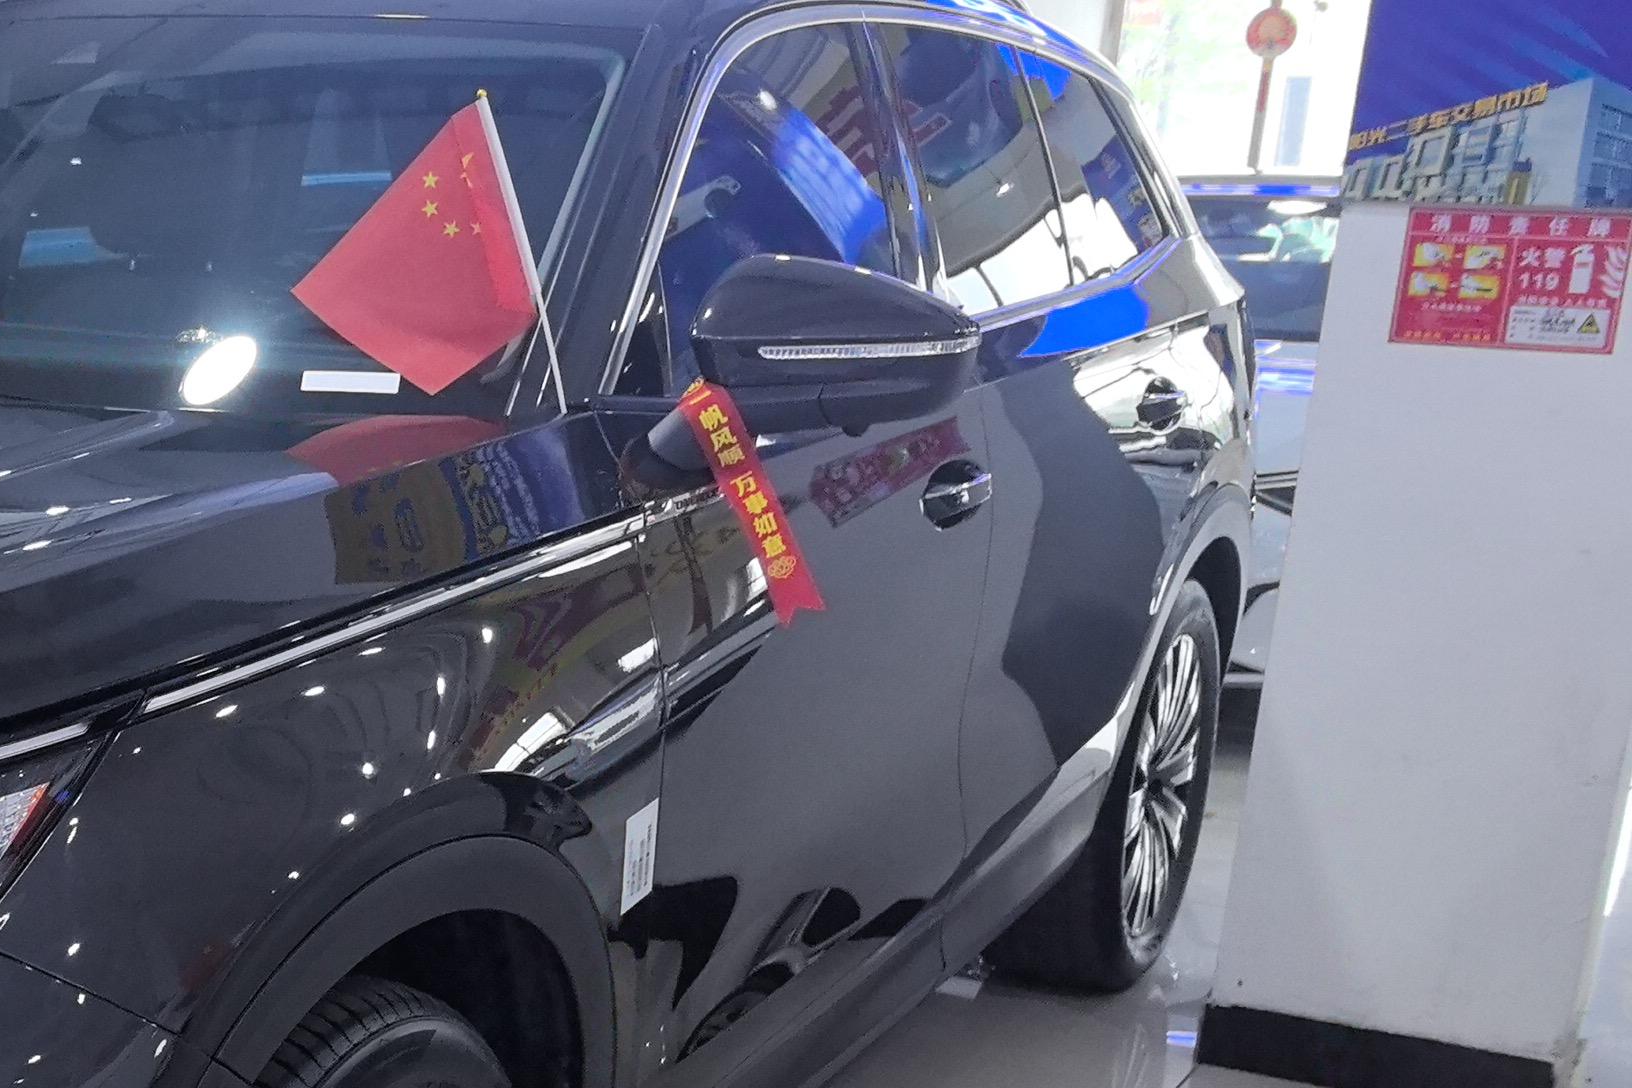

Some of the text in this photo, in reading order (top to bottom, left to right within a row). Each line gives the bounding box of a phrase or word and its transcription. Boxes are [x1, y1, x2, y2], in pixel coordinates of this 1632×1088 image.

[1518, 271, 1561, 291] 119
[689, 389, 746, 469] 一帆风顺
[729, 470, 788, 559] 万事如意
